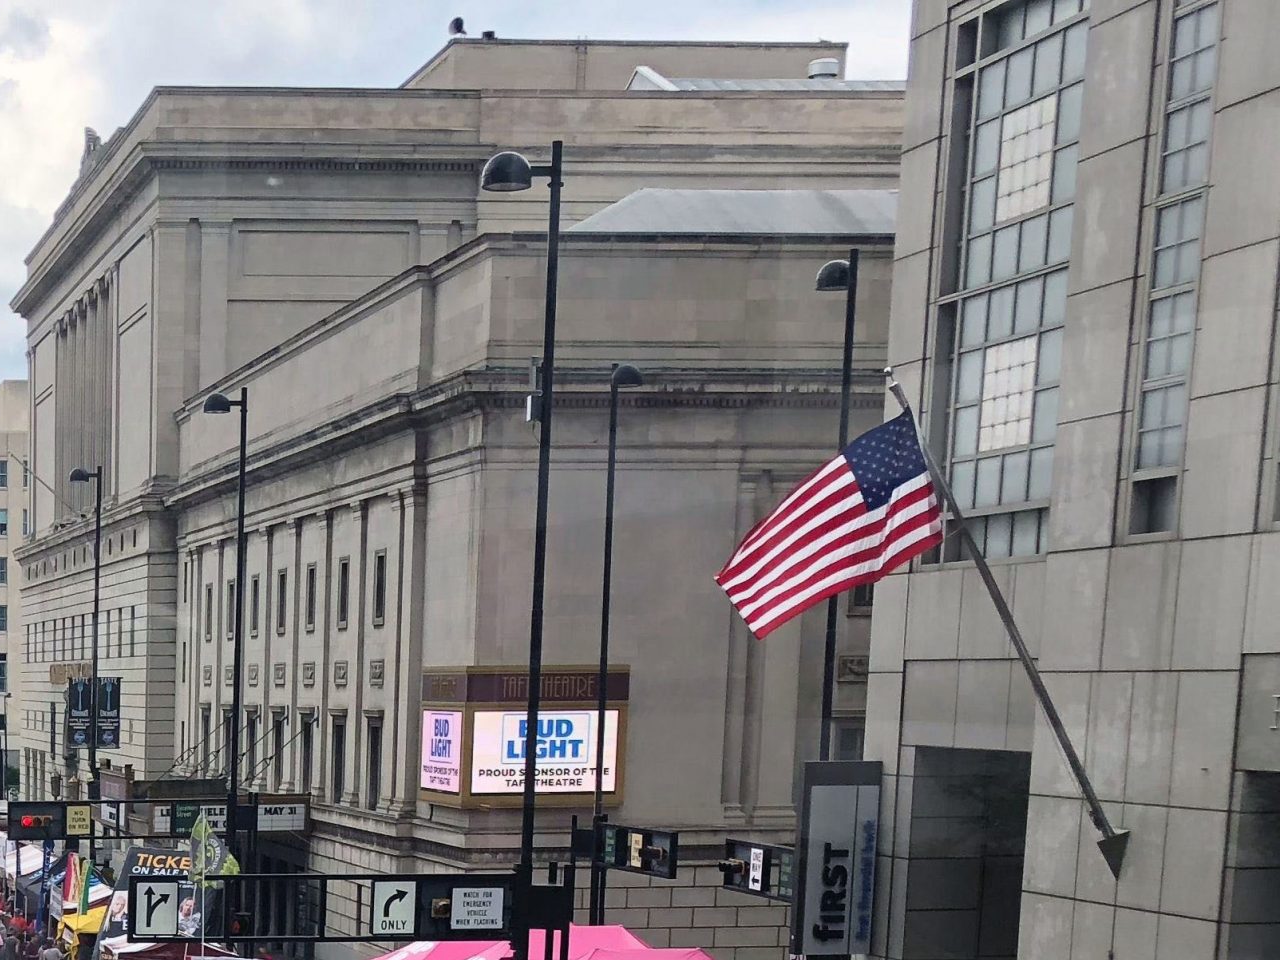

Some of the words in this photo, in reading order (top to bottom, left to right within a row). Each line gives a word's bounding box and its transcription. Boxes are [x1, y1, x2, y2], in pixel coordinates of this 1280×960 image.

[538, 676, 595, 698] THEATRE
[434, 718, 450, 737] BUD
[431, 739, 452, 758] LIGHT
[507, 739, 583, 759] LIGHT
[478, 768, 516, 777] PROUD
[519, 767, 570, 777] SONSOR
[573, 767, 587, 776] OF
[589, 767, 610, 776] TE
[505, 778, 529, 787] TAF
[535, 778, 583, 787] THEATRE
[263, 806, 284, 816] MAY
[287, 806, 297, 815] 31
[136, 853, 192, 869] TICKE
[131, 865, 150, 875] ON
[467, 909, 487, 917] VEHICLE
[380, 920, 408, 931] ONLY
[455, 918, 470, 926] WHEN
[473, 918, 498, 926] FLASHING
